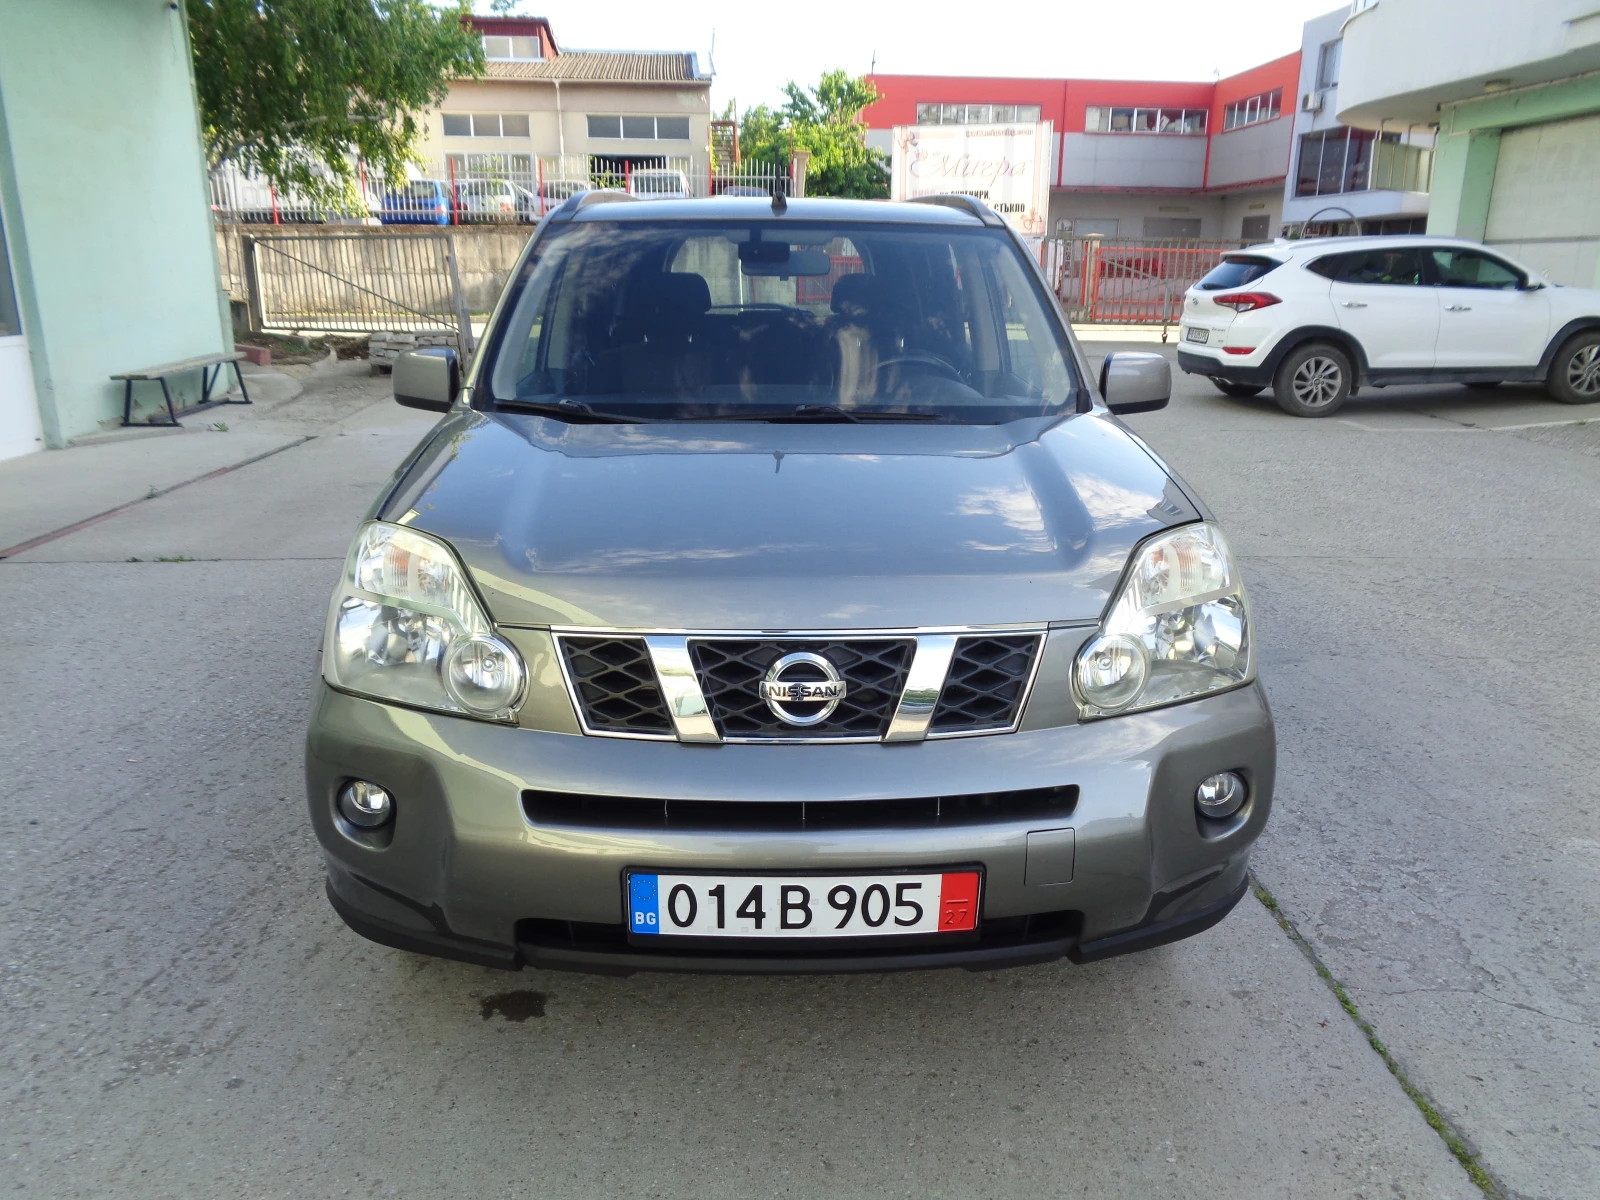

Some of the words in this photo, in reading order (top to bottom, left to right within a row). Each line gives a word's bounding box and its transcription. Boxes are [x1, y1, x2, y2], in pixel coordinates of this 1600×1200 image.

[768, 685, 837, 698] NISSAN
[635, 911, 657, 925] BG
[945, 908, 968, 924] 27
